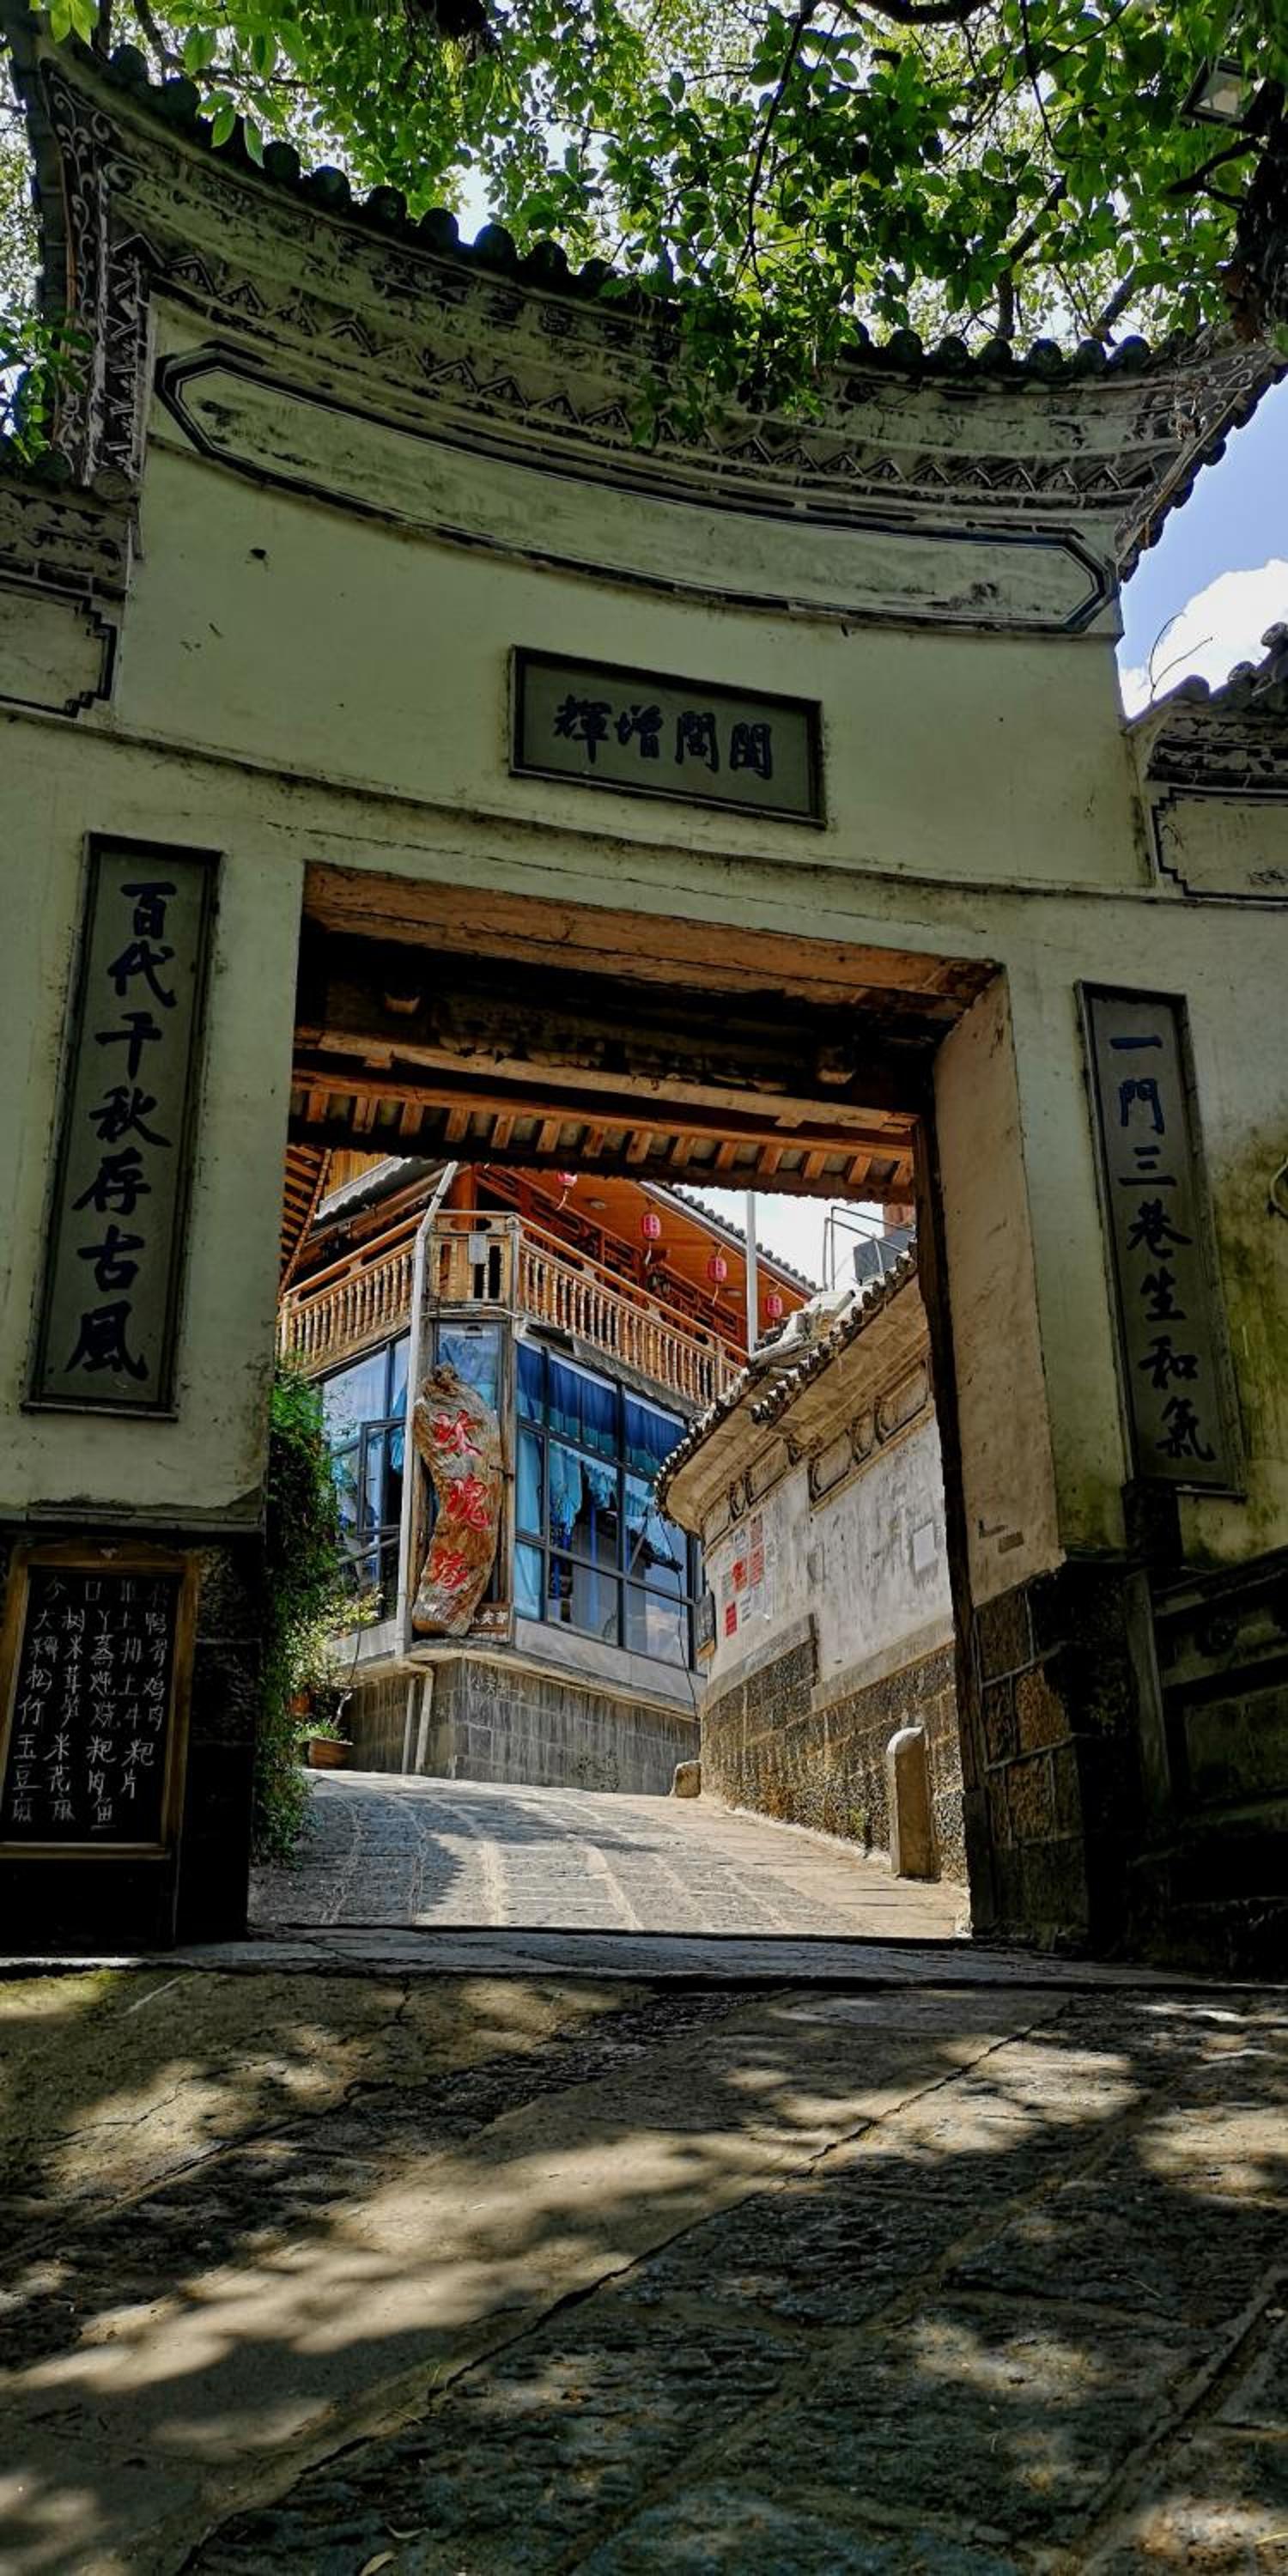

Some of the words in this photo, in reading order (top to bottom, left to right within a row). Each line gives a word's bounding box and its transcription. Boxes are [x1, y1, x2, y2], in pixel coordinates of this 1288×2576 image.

[65, 882, 177, 1382] 百代千秋存古風
[1109, 1036, 1216, 1462] 一門三巷生和氣
